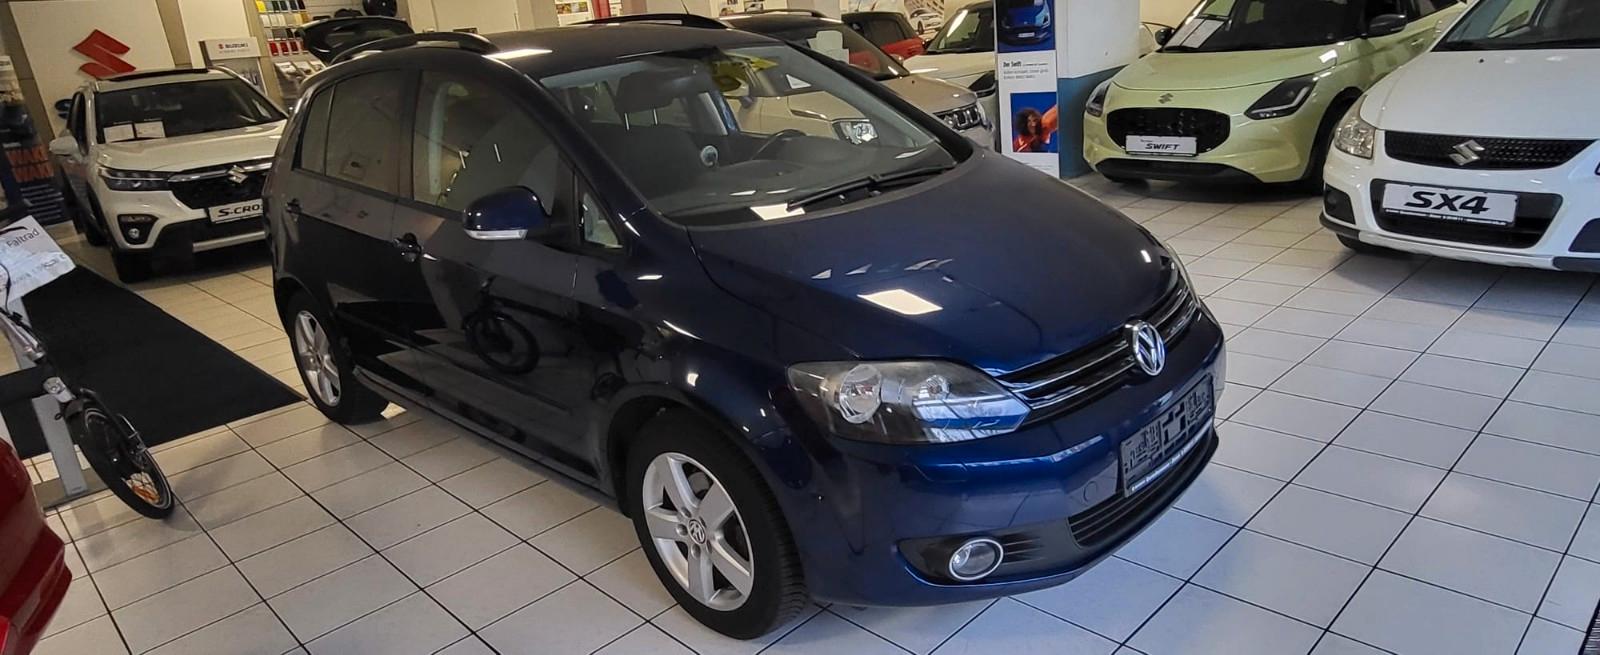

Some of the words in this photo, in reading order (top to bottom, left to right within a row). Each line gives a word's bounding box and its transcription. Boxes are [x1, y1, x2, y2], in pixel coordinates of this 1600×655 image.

[1145, 142, 1180, 150] SWIFT
[217, 204, 263, 217] S-CRO
[1404, 191, 1491, 214] SX4
[6, 228, 40, 248] Faltrad
